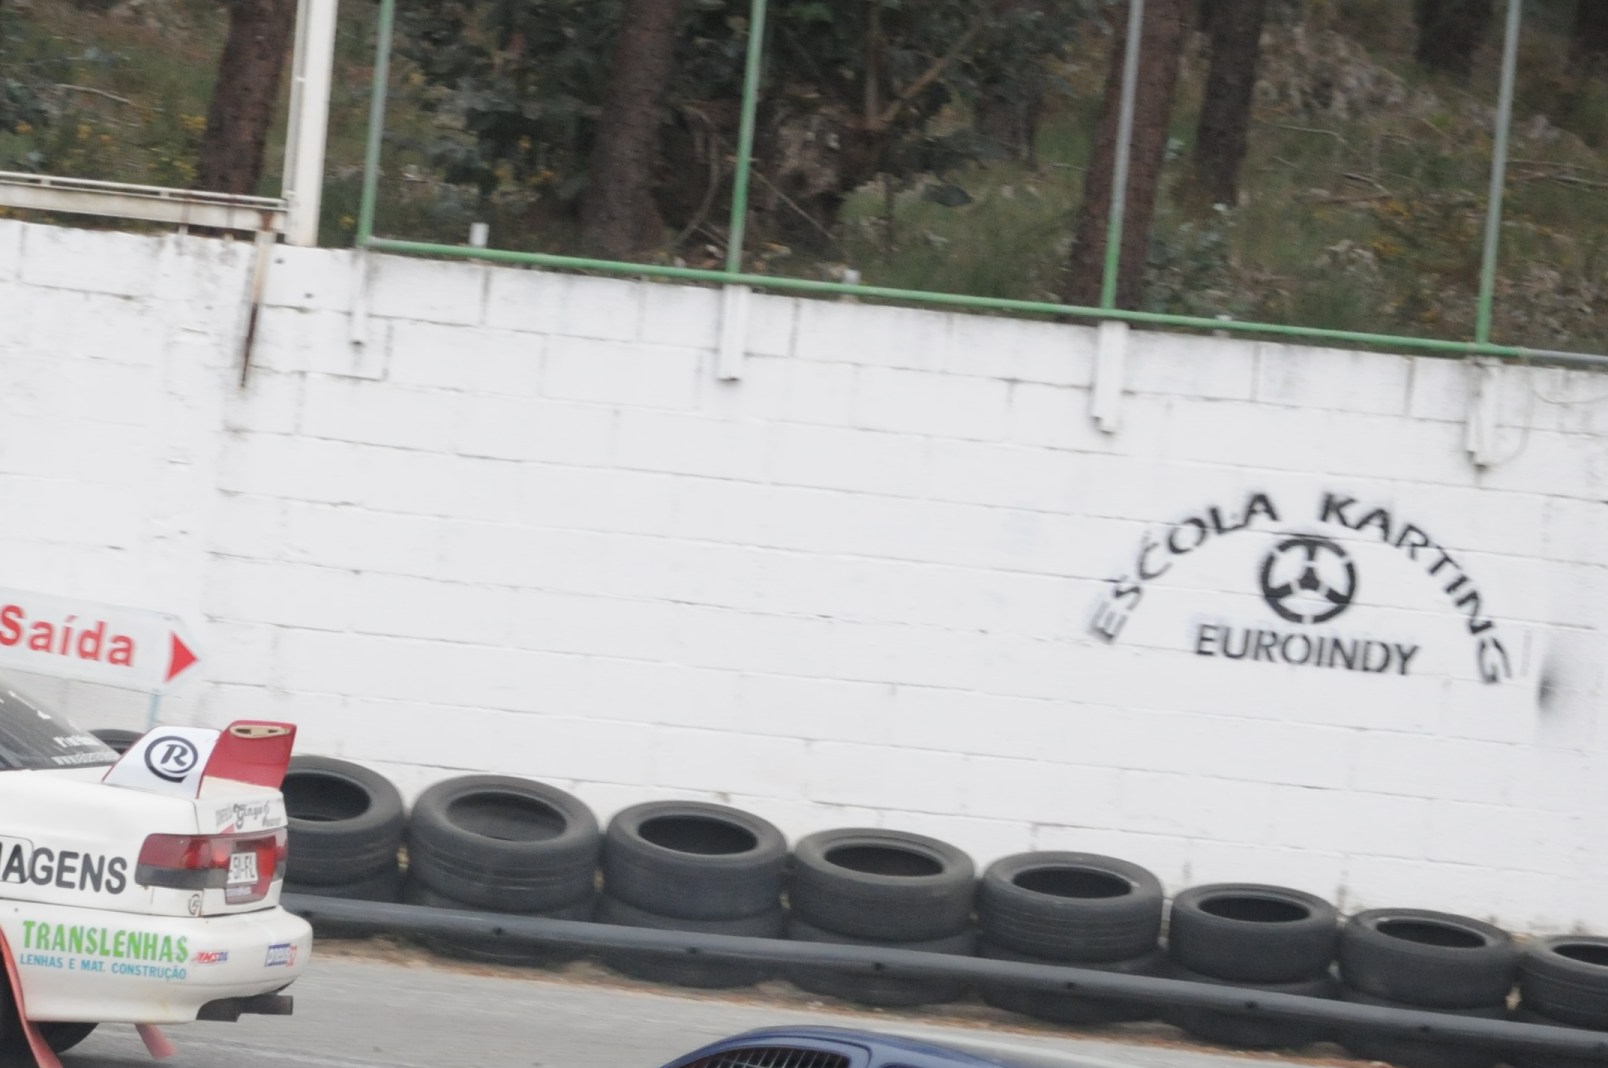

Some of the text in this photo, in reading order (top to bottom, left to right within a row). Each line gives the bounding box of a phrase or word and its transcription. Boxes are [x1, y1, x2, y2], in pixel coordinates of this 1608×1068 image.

[1089, 492, 1513, 684] ESCOLA KARTING
[1194, 623, 1420, 676] EUROINDY
[23, 920, 189, 963] TRANSLENHAS
[20, 953, 187, 981] LENHAS E MAT. CONSTRUÇÃO
